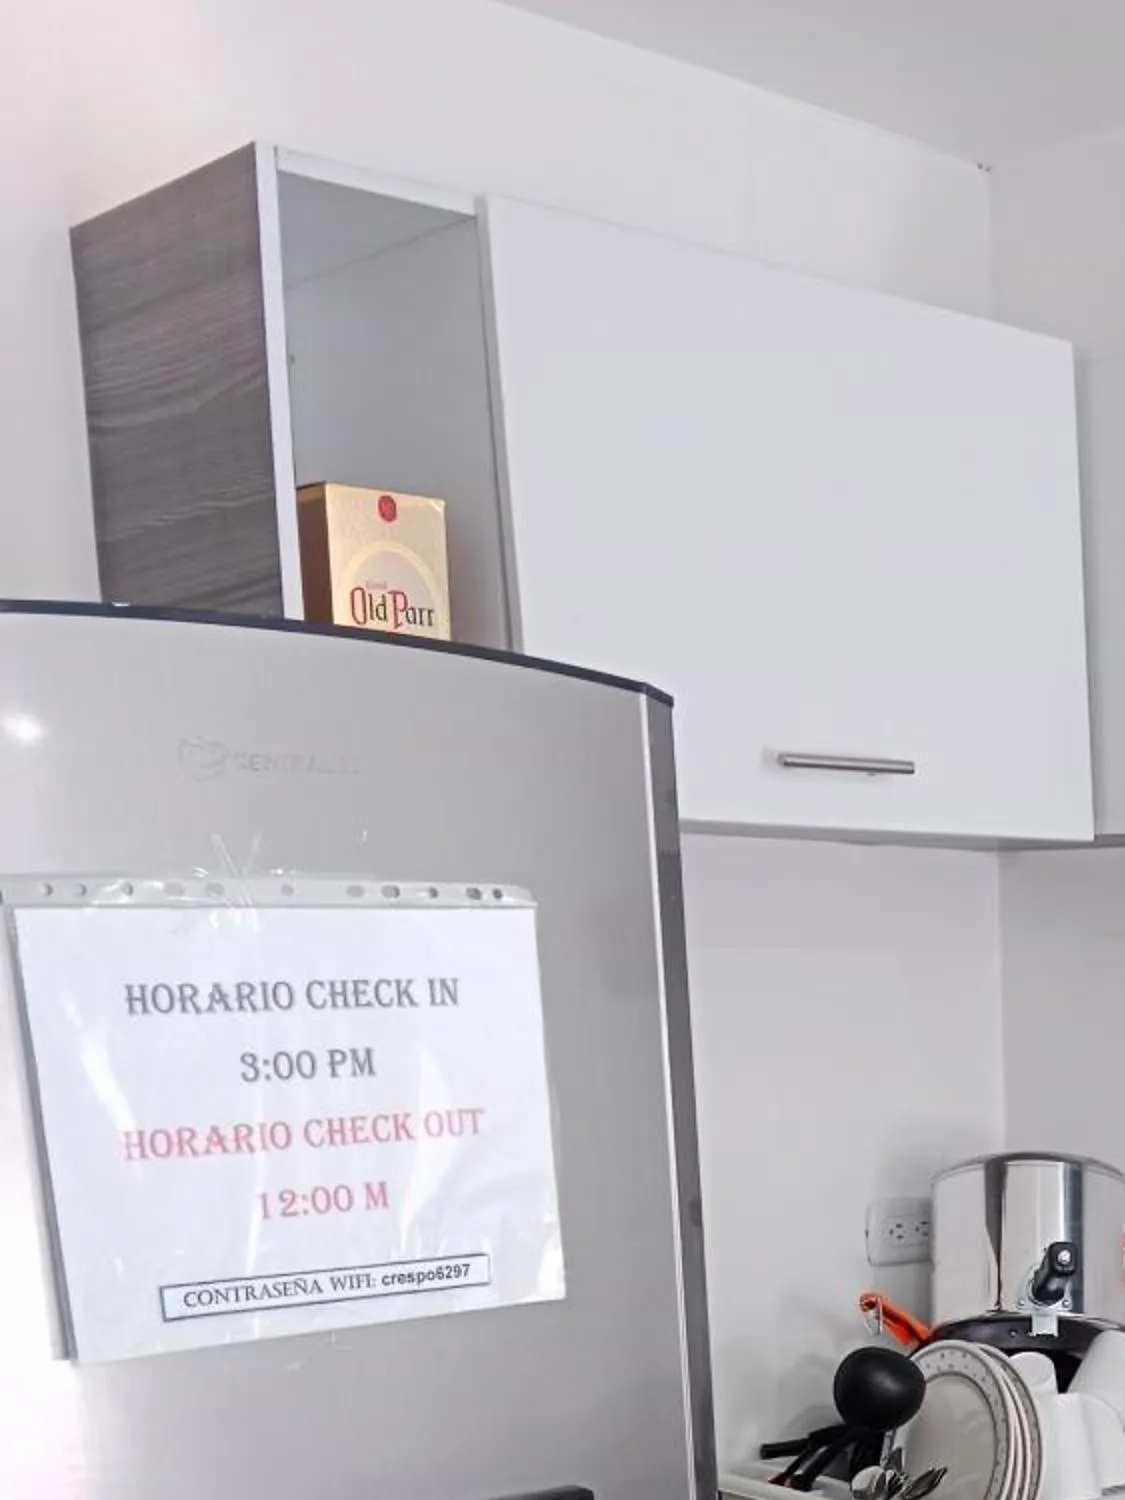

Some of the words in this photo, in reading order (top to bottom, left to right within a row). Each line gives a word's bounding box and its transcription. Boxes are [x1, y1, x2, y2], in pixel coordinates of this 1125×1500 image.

[350, 586, 389, 625] Old
[389, 590, 435, 629] Parr
[124, 980, 295, 1015] HORARIO
[305, 977, 419, 1010] CHECK
[428, 976, 460, 1008] IN
[239, 1049, 317, 1083] 3:00
[327, 1047, 377, 1079] PM
[122, 1120, 292, 1161] HORARIO
[303, 1112, 416, 1149] CHECK
[424, 1107, 486, 1139] OUT
[255, 1183, 355, 1221] 12:00
[364, 1180, 390, 1211] M
[182, 1276, 325, 1309] CONTRASEÑA
[329, 1271, 377, 1293] WIFI:
[380, 1263, 471, 1287] crespo6297
